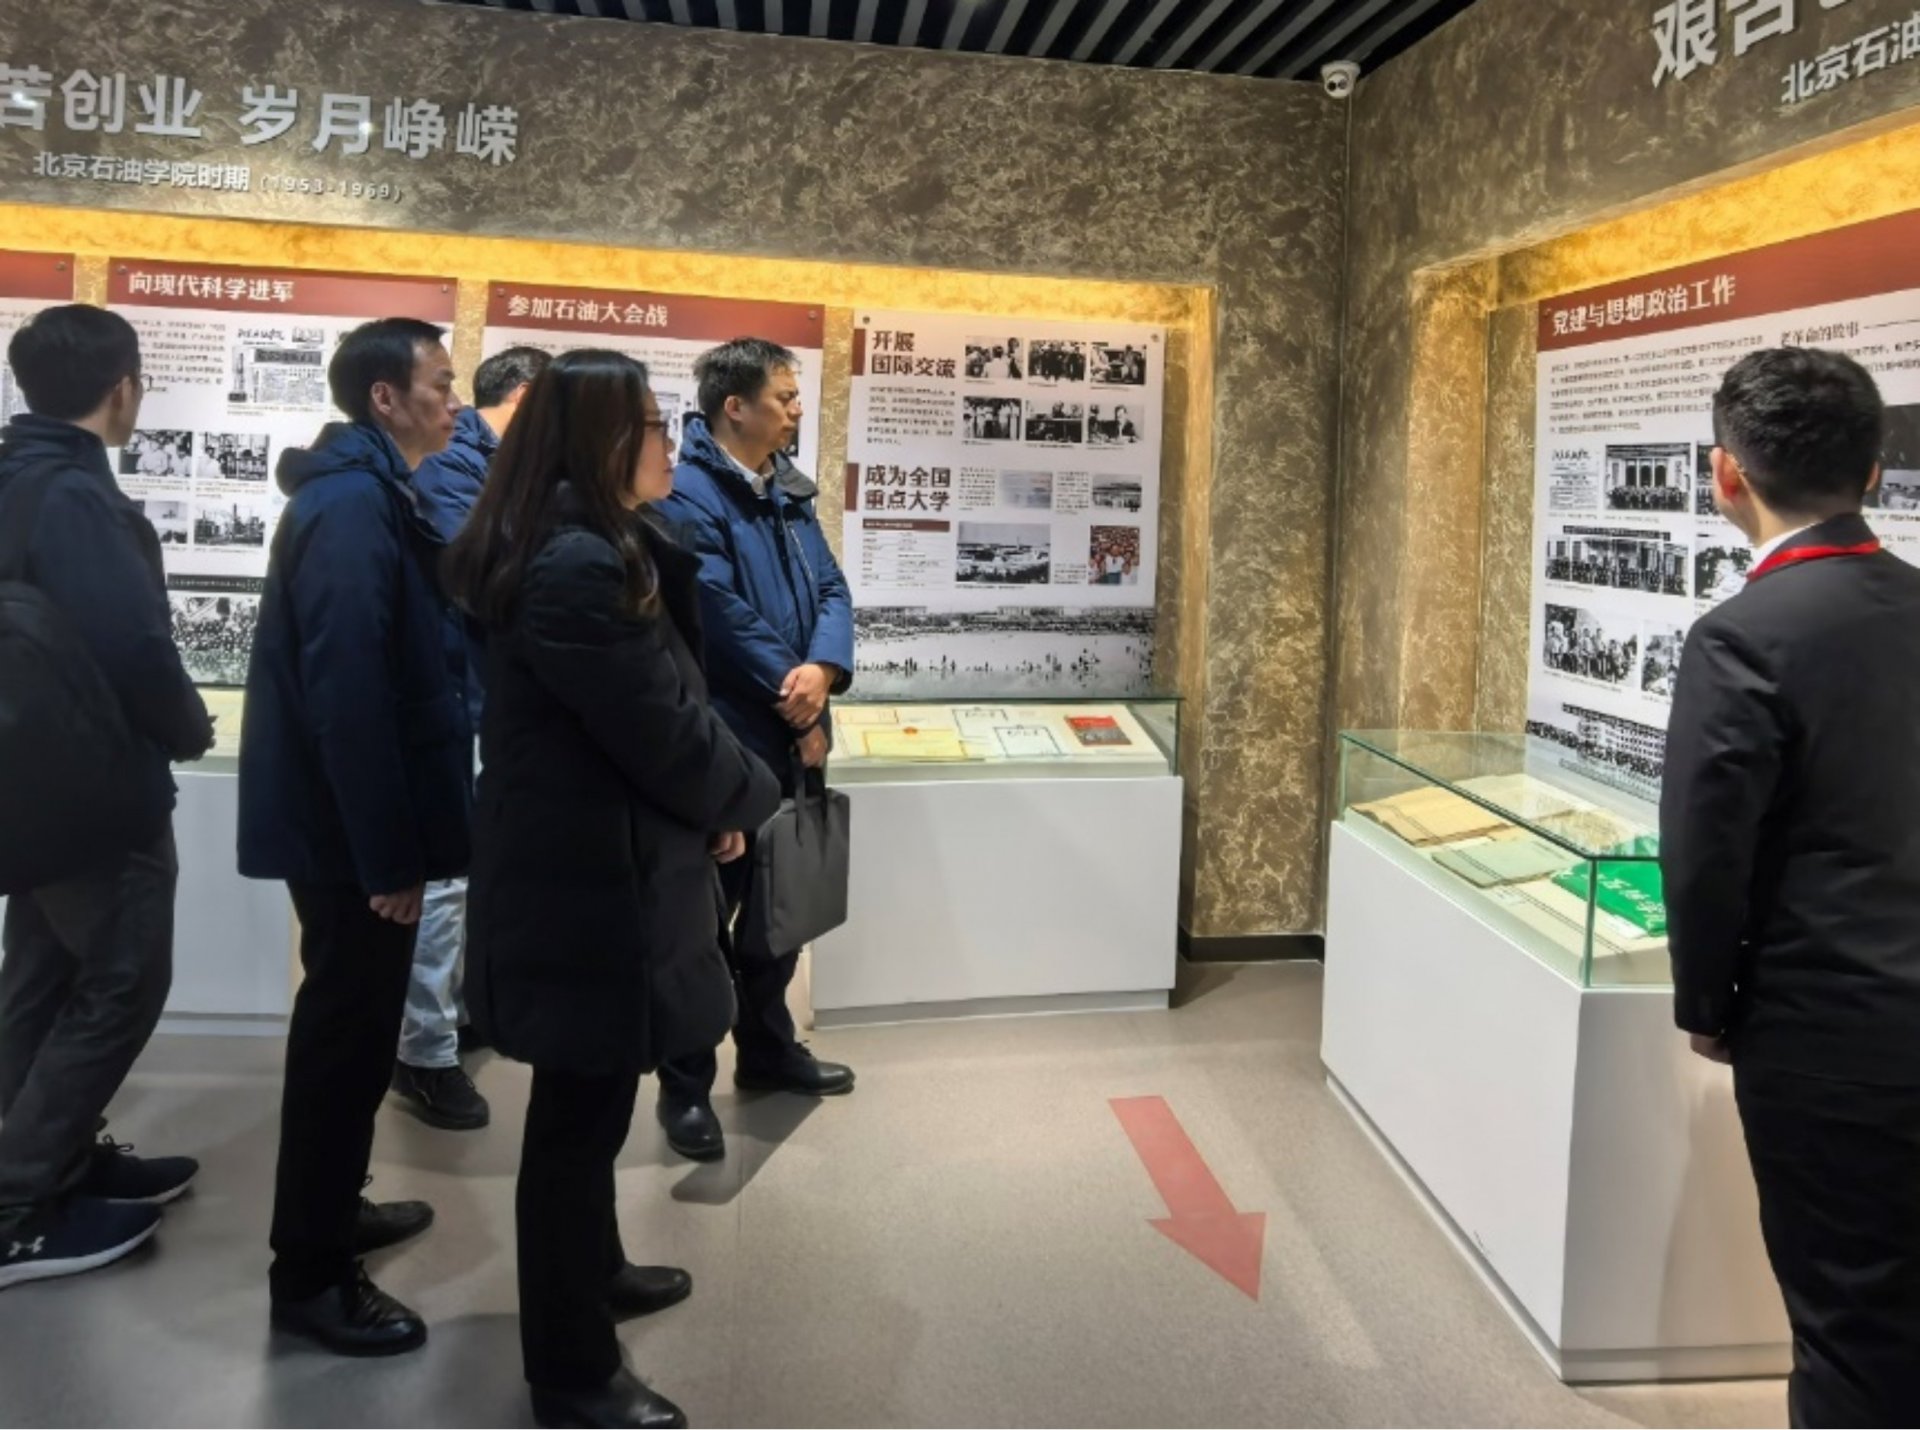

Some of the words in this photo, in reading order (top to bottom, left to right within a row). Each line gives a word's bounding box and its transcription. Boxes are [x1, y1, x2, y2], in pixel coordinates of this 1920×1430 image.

[0, 62, 203, 138] 苦创业
[239, 84, 519, 166] 岁月峥嵘
[33, 150, 250, 192] 北京石油学院时期
[128, 271, 295, 303] 向现代科学进军
[507, 294, 669, 327] 参加石油大会战
[1552, 273, 1737, 336] 党建与思想政治工作
[871, 329, 915, 353] 开展
[870, 352, 956, 379] 国际交流
[864, 464, 951, 489] 成为全国
[864, 488, 951, 512] 重点大学
